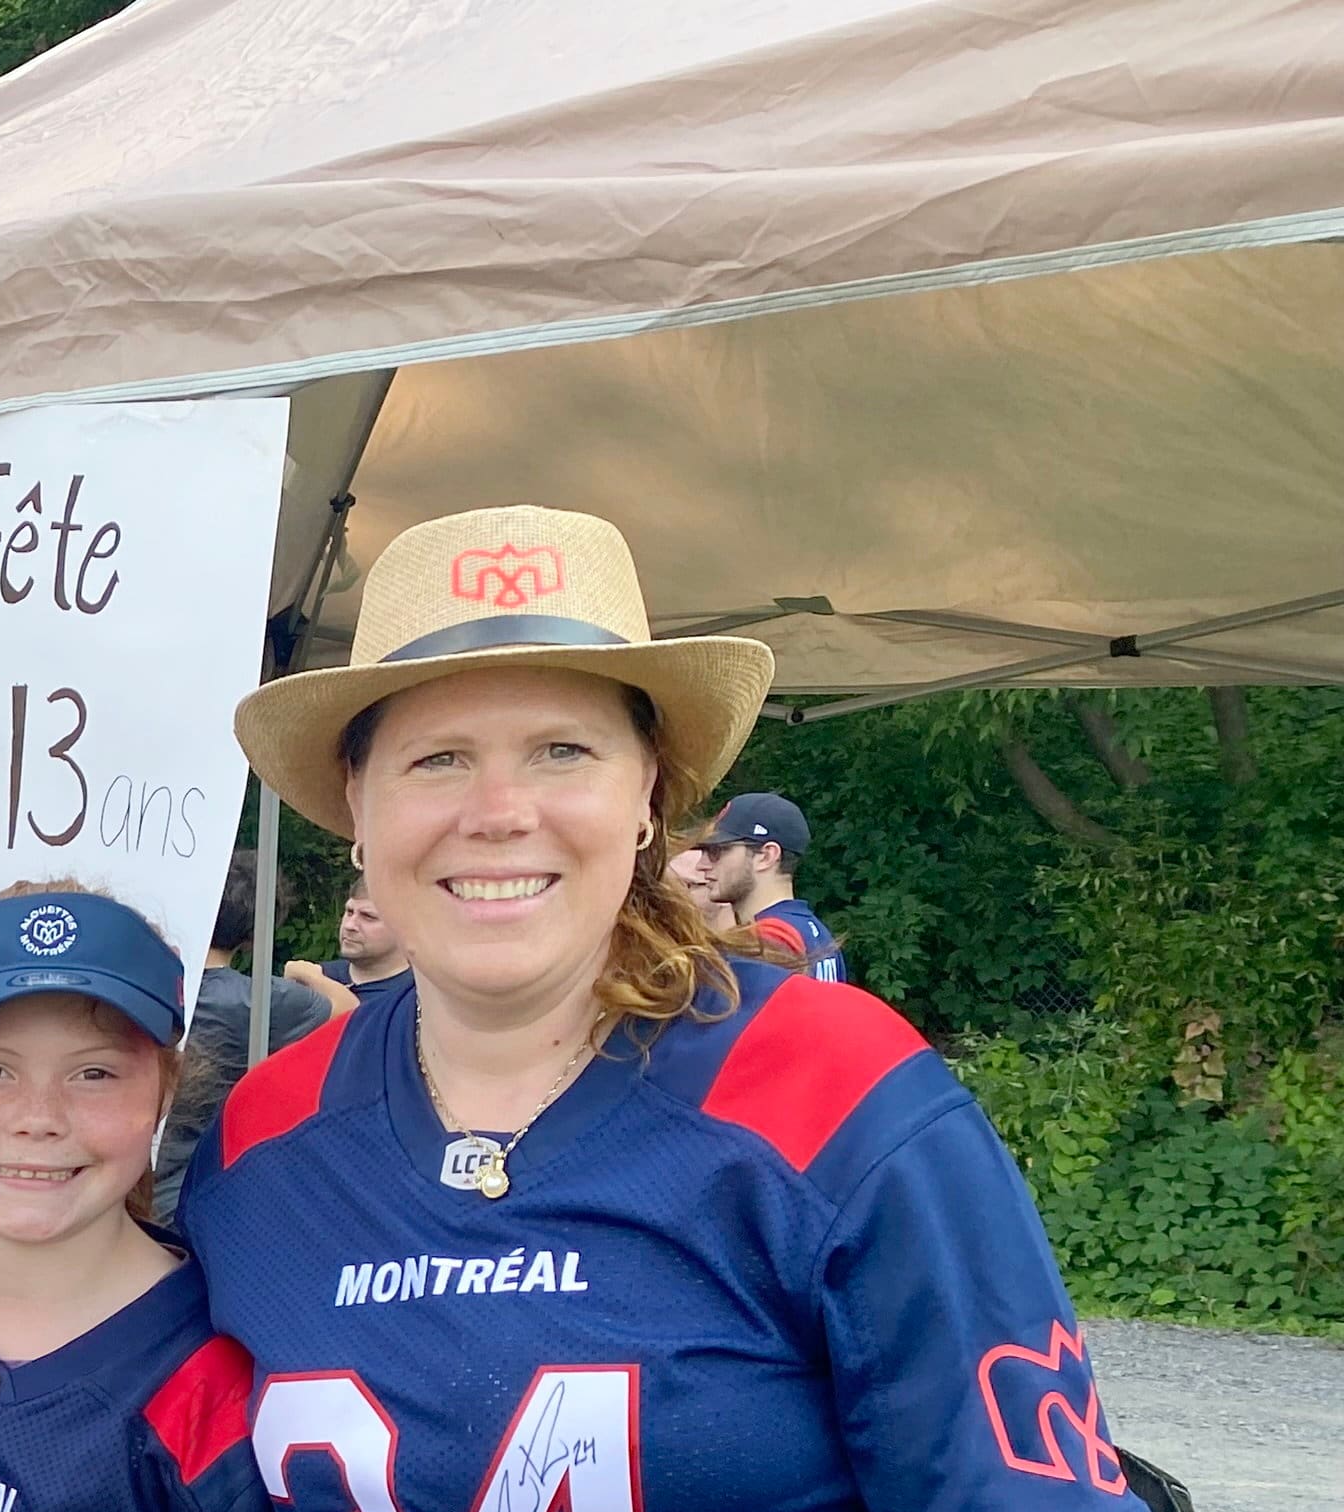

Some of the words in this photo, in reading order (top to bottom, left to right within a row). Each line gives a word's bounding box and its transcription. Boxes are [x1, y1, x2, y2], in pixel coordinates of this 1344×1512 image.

[7, 683, 88, 849] 13
[100, 774, 206, 858] ans
[19, 904, 78, 931] ALOUETTES
[334, 1248, 589, 1307] MONTRÉAL
